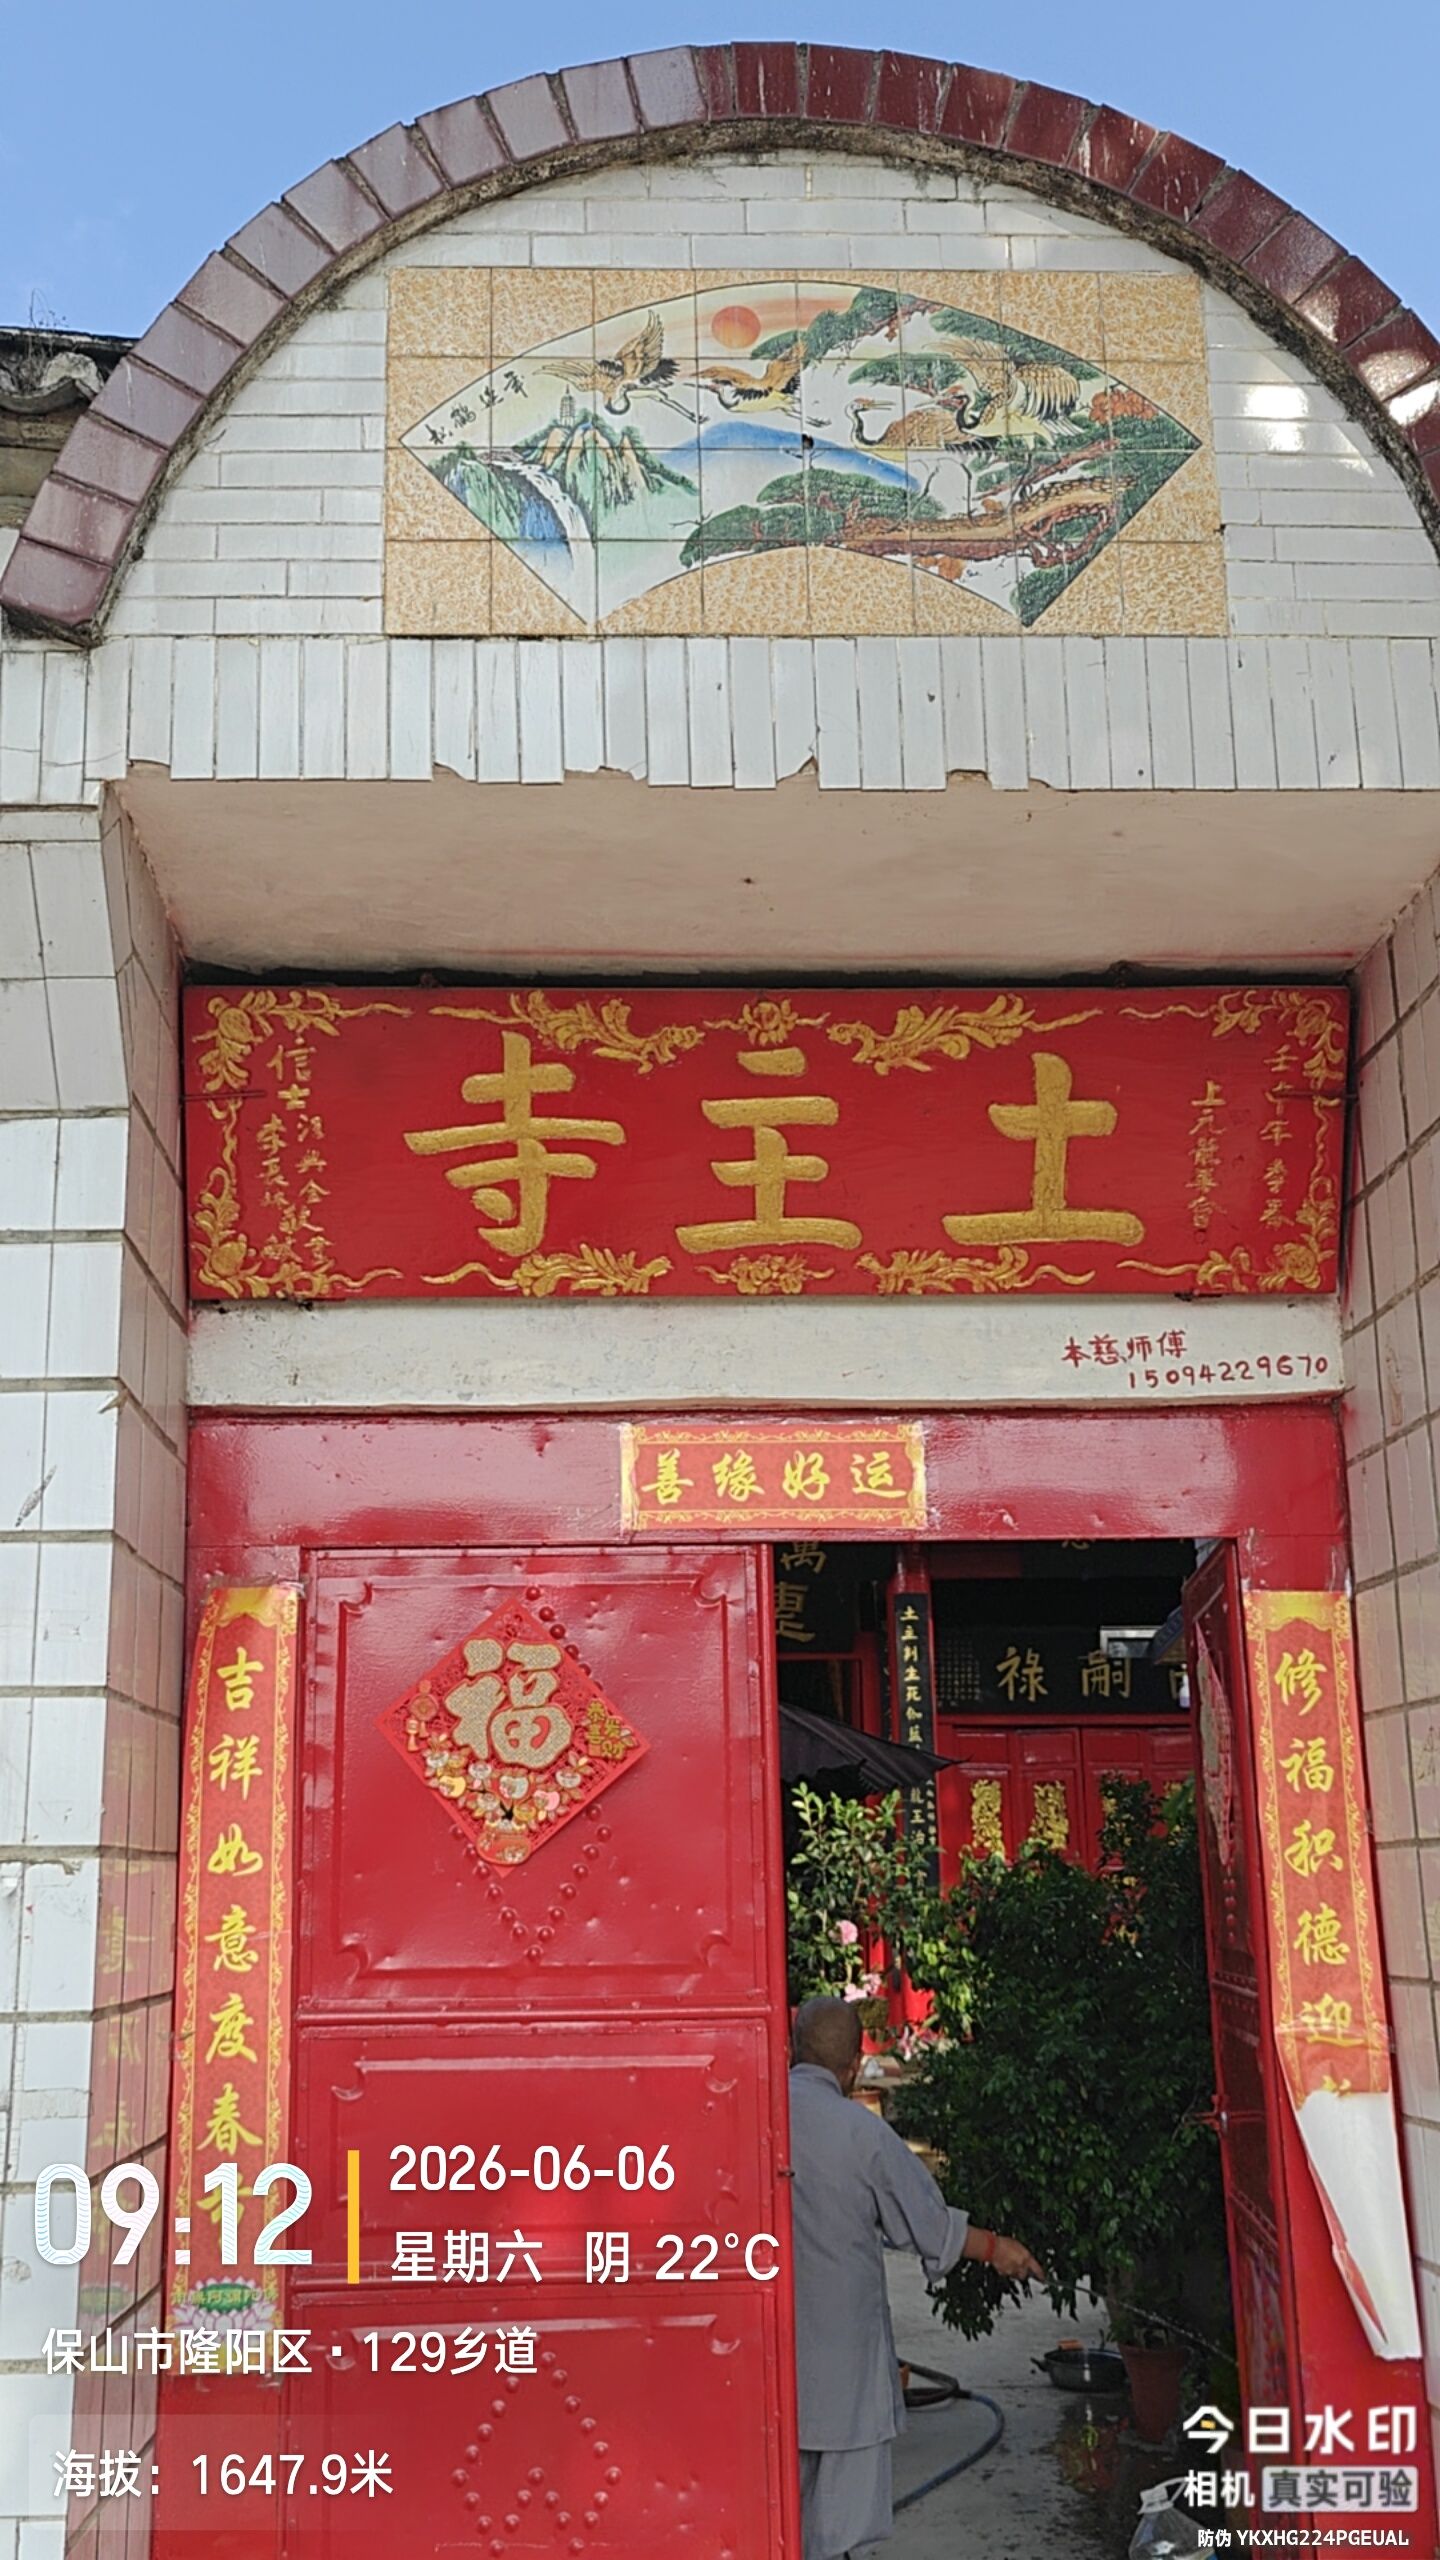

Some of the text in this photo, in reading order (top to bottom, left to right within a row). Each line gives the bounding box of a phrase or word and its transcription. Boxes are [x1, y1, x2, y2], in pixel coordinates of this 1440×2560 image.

[1129, 1355, 1328, 1389] 15094229670
[641, 1448, 906, 1505] 善缘好运
[444, 1637, 574, 1770] 福
